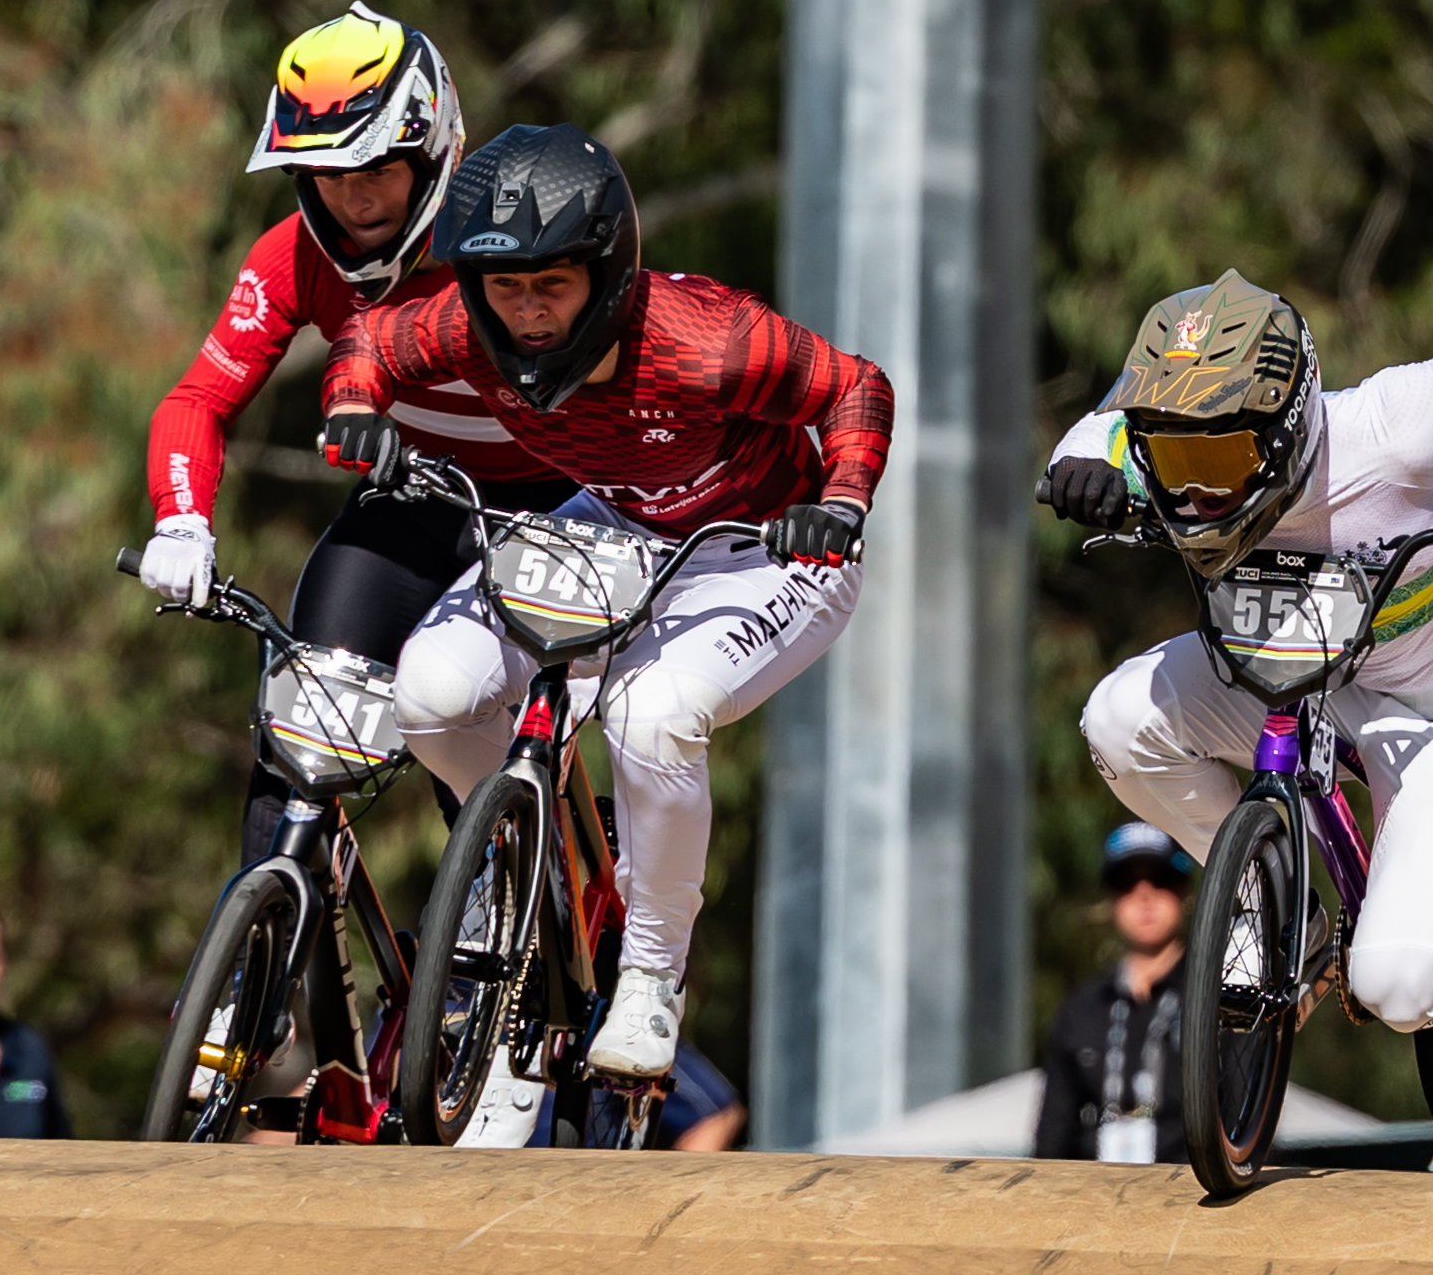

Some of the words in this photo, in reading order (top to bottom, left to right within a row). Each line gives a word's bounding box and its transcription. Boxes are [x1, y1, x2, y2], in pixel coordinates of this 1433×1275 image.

[468, 237, 510, 249] BELL
[628, 409, 675, 420] ANCH
[659, 495, 698, 514] Latvijas
[565, 518, 597, 539] box
[1276, 550, 1307, 567] box
[515, 548, 617, 607] 545
[1239, 569, 1258, 579] UCI
[1232, 587, 1335, 642] 553
[290, 679, 385, 746] 541
